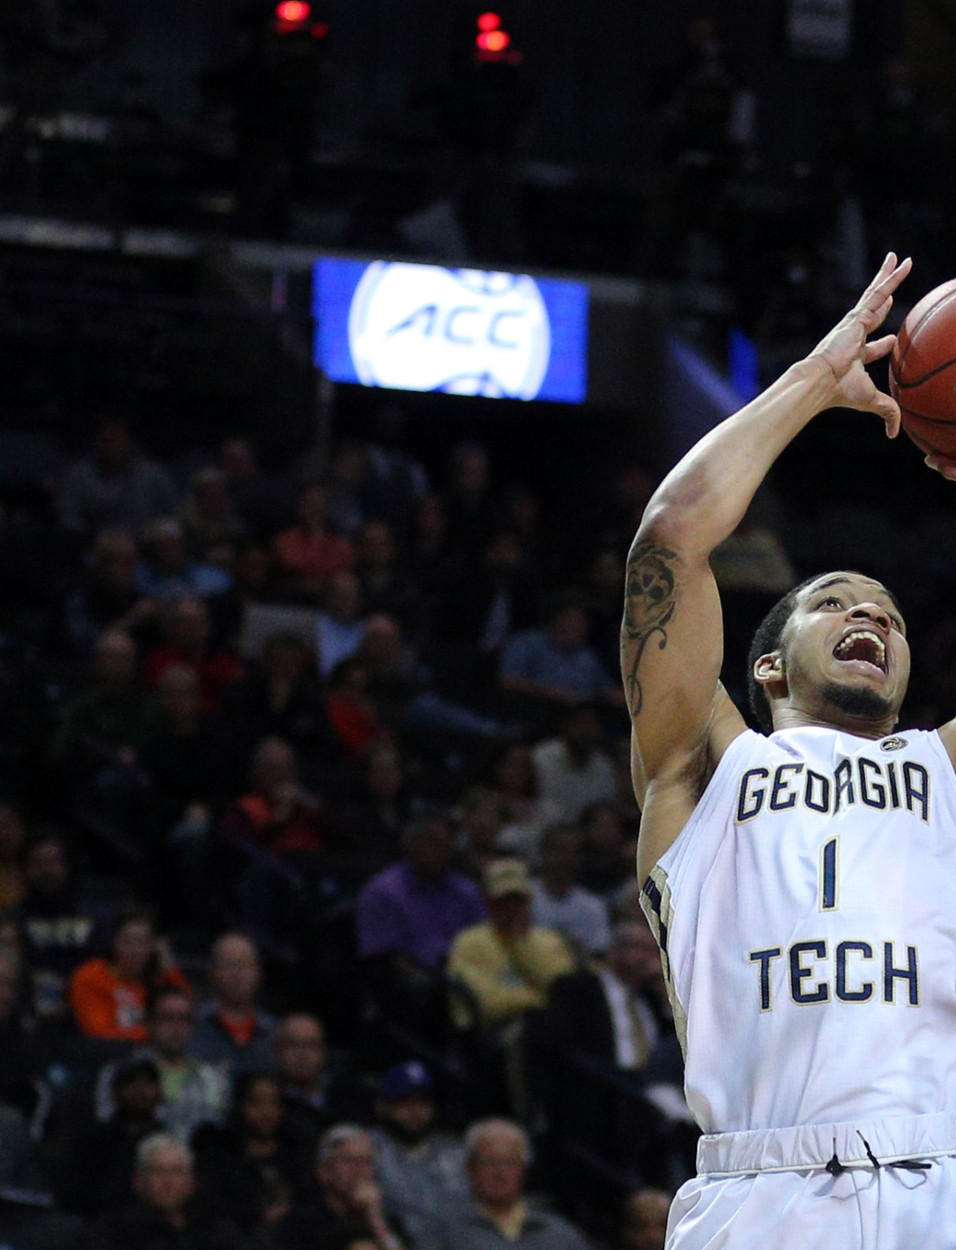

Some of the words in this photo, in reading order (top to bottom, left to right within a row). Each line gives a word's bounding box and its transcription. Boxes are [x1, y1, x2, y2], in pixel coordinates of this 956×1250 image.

[387, 303, 527, 349] ACC
[736, 756, 930, 826] GEORGIA
[818, 835, 841, 913] 1
[748, 938, 921, 1013] TECH
